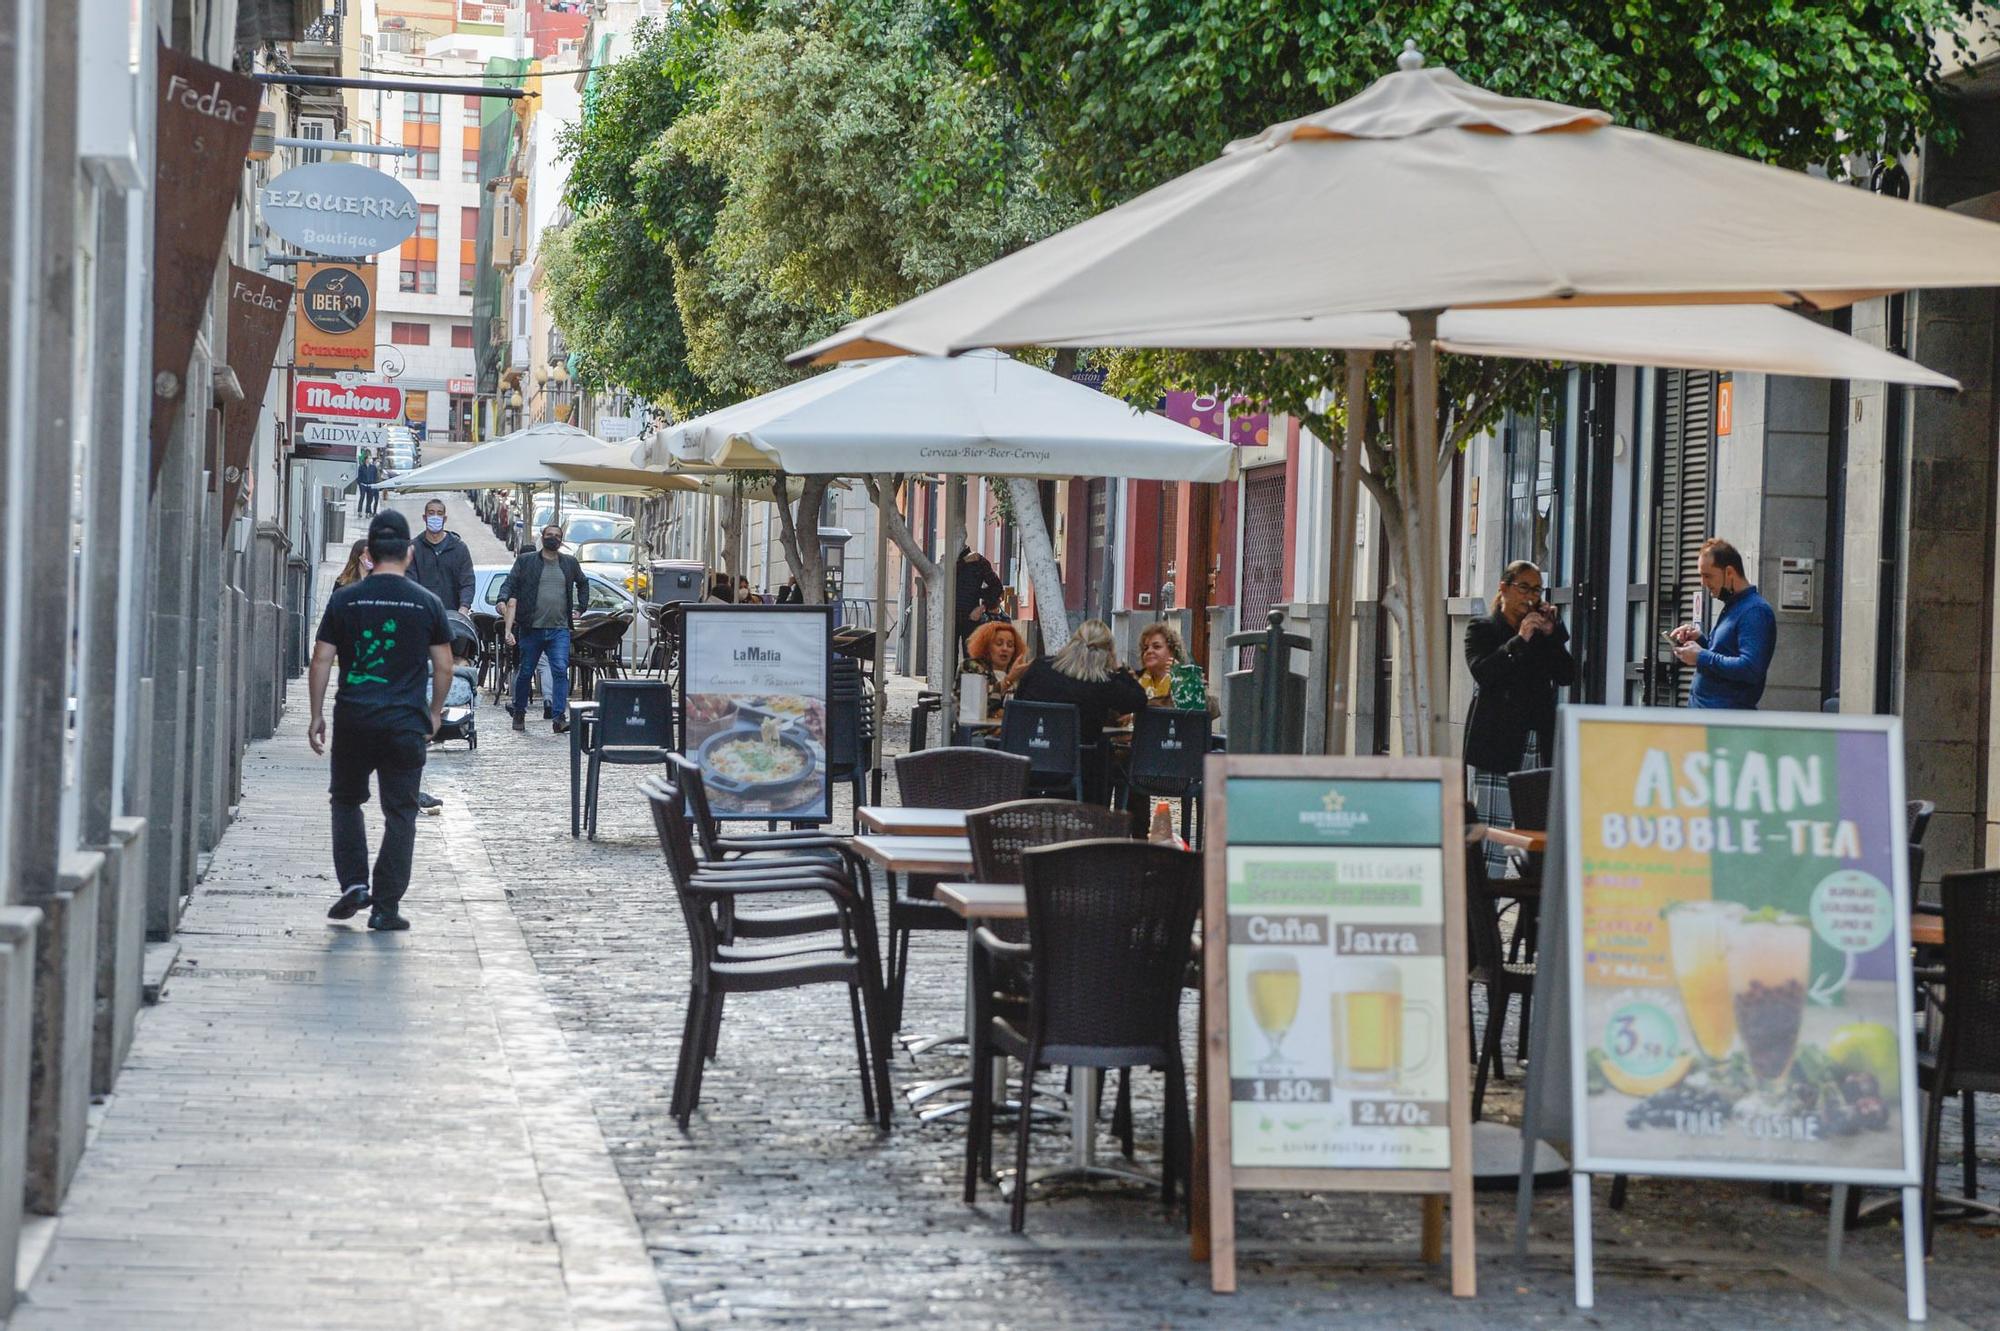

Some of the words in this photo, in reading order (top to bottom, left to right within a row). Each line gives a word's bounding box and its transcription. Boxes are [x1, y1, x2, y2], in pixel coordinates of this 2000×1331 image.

[166, 75, 247, 126] Fedac
[266, 190, 416, 219] EZQUERRA
[303, 229, 377, 248] Boutique
[233, 281, 283, 312] Fedac
[306, 387, 391, 413] Mahou
[1720, 388, 1728, 429] R
[311, 427, 382, 444] MIDWAY
[1601, 813, 1862, 859] BUBBLE-TEA
[1247, 915, 1320, 942] Caña
[1340, 926, 1418, 954] Jarra
[1359, 1101, 1431, 1125] 2.70€
